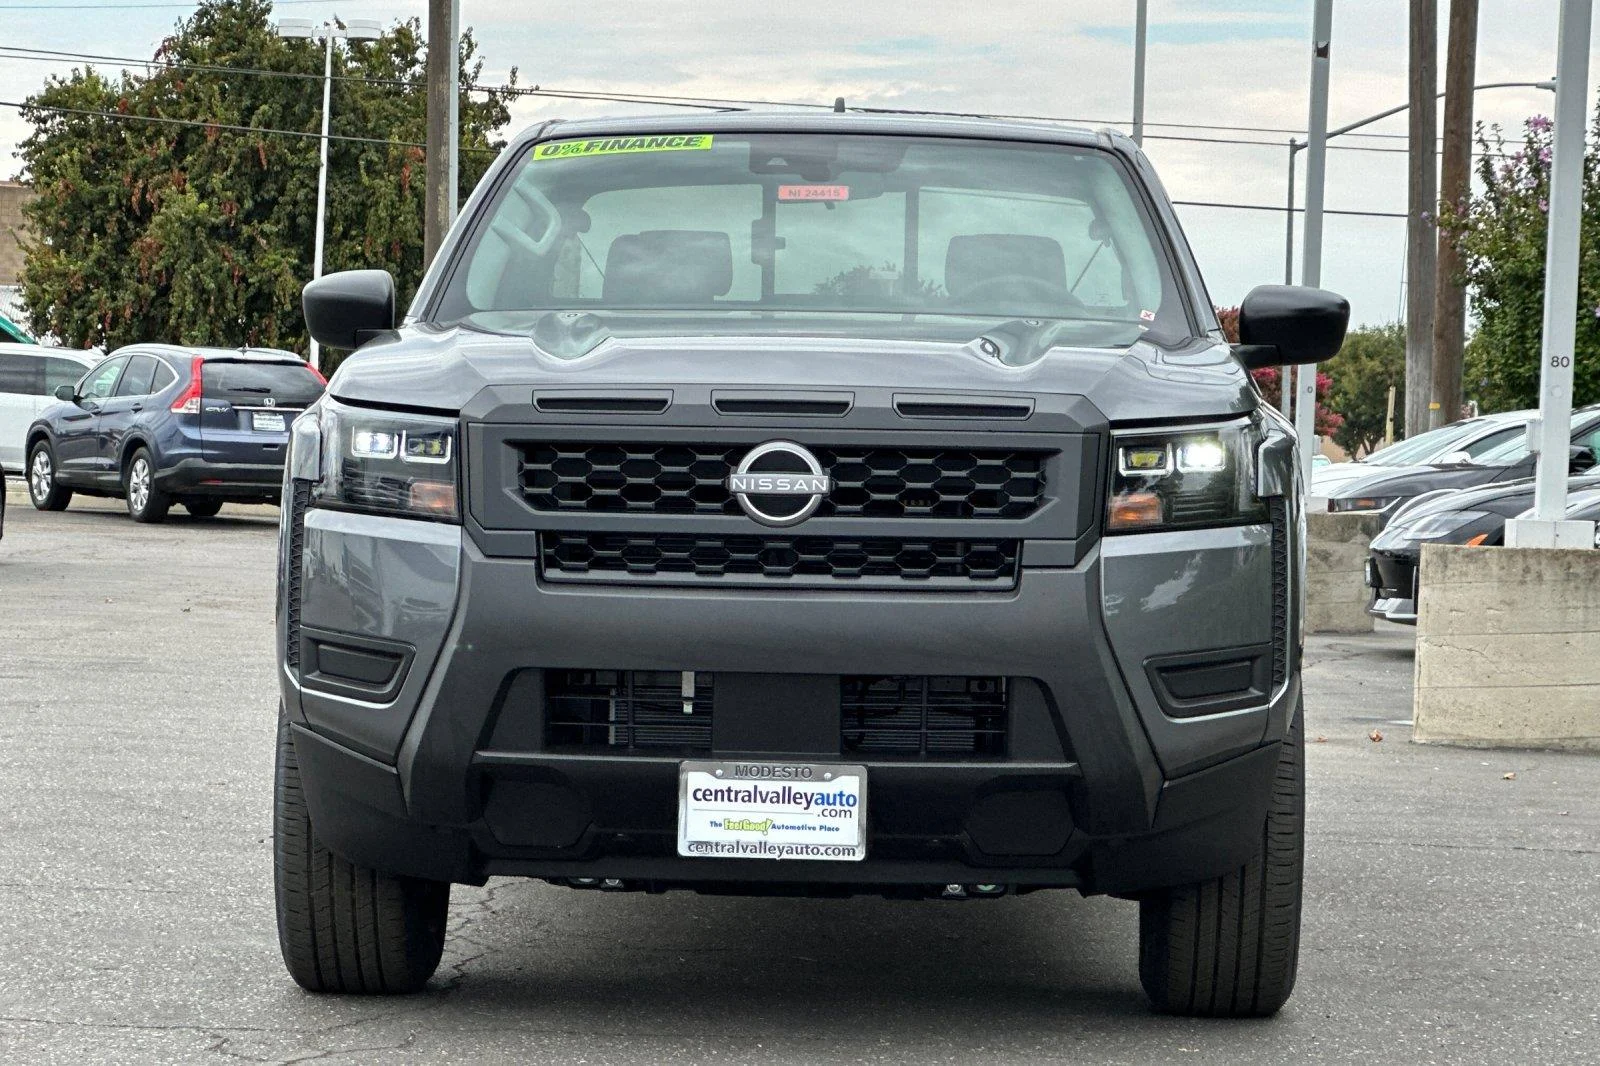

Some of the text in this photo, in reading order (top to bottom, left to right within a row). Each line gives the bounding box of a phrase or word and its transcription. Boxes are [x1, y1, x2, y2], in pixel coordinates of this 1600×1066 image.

[541, 136, 705, 157] 0% FINANCE
[1551, 356, 1570, 368] 80
[732, 478, 827, 491] NISSAN
[734, 765, 813, 779] MODESTO
[692, 785, 858, 810] centralvalleyauto
[817, 808, 853, 819] .com
[710, 820, 723, 828] The
[771, 823, 817, 832] Automotive
[819, 825, 840, 833] Place
[687, 841, 856, 858] centralvalleyauto.com
